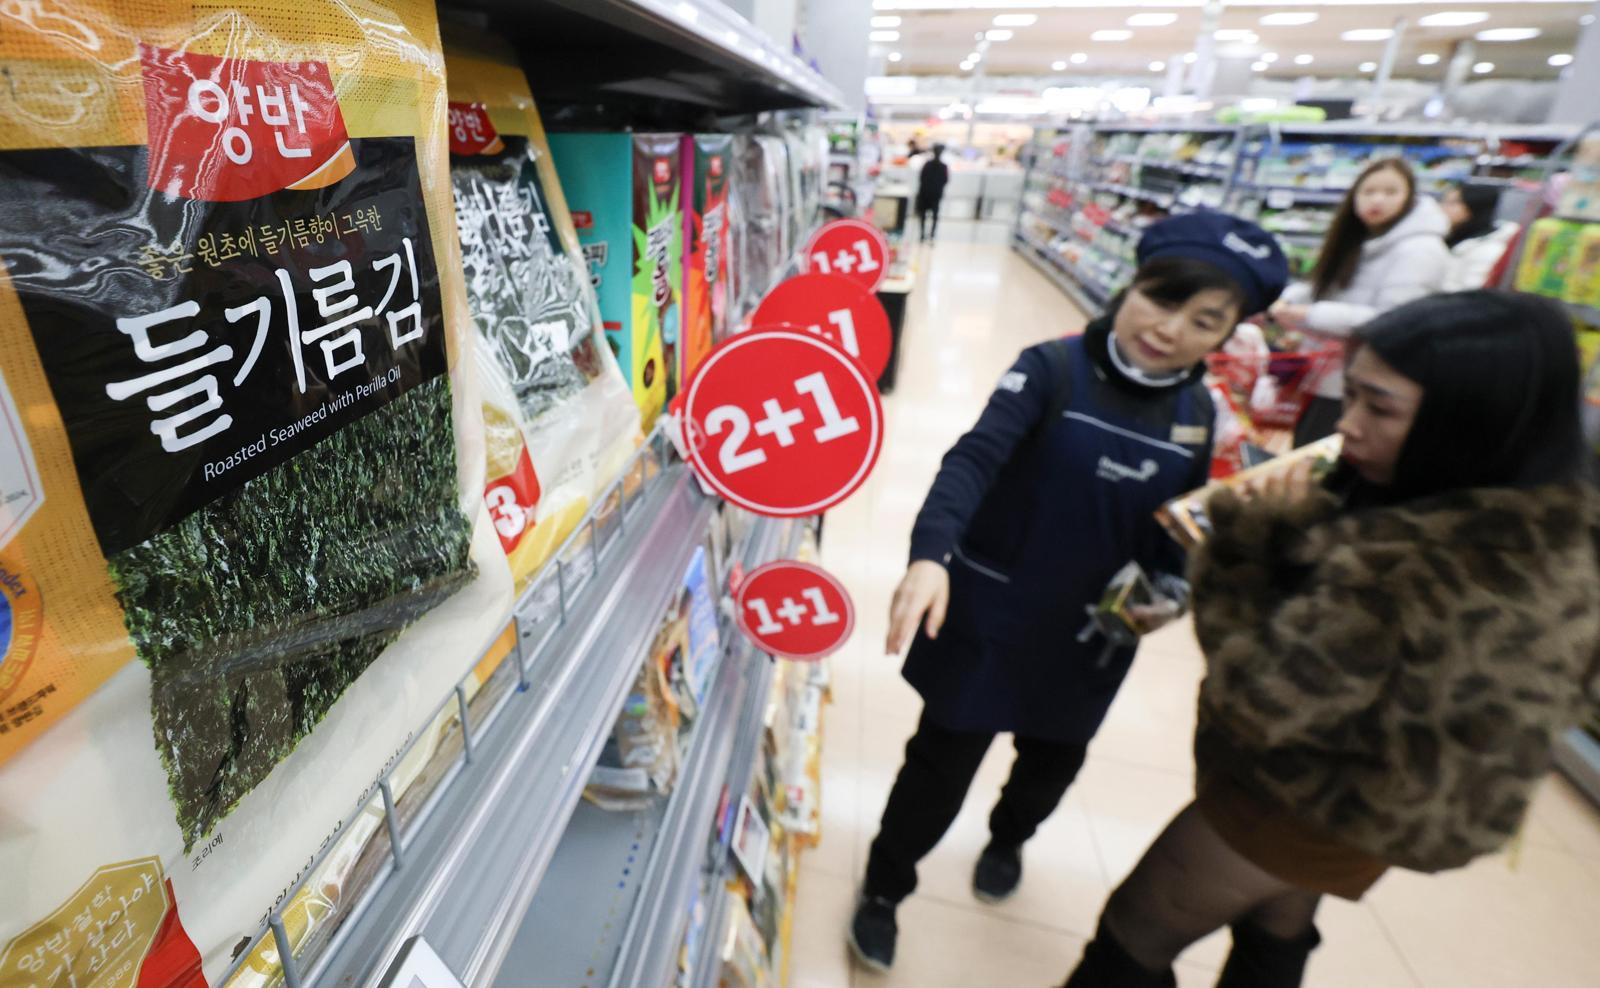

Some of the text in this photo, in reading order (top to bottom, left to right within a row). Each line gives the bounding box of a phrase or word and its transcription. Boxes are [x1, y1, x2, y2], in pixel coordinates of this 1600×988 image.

[187, 79, 312, 166] 양반
[137, 205, 383, 280] 좋은 원초에 들기름향이 그윽한
[812, 239, 880, 274] 1+1
[105, 237, 424, 454] 들기름김
[204, 365, 401, 482] Roasted Seaweed with Perilla Oil
[704, 371, 861, 475] 2+1
[749, 585, 840, 636] 1+1
[192, 832, 224, 872] 조리예
[17, 927, 72, 974] 양반
